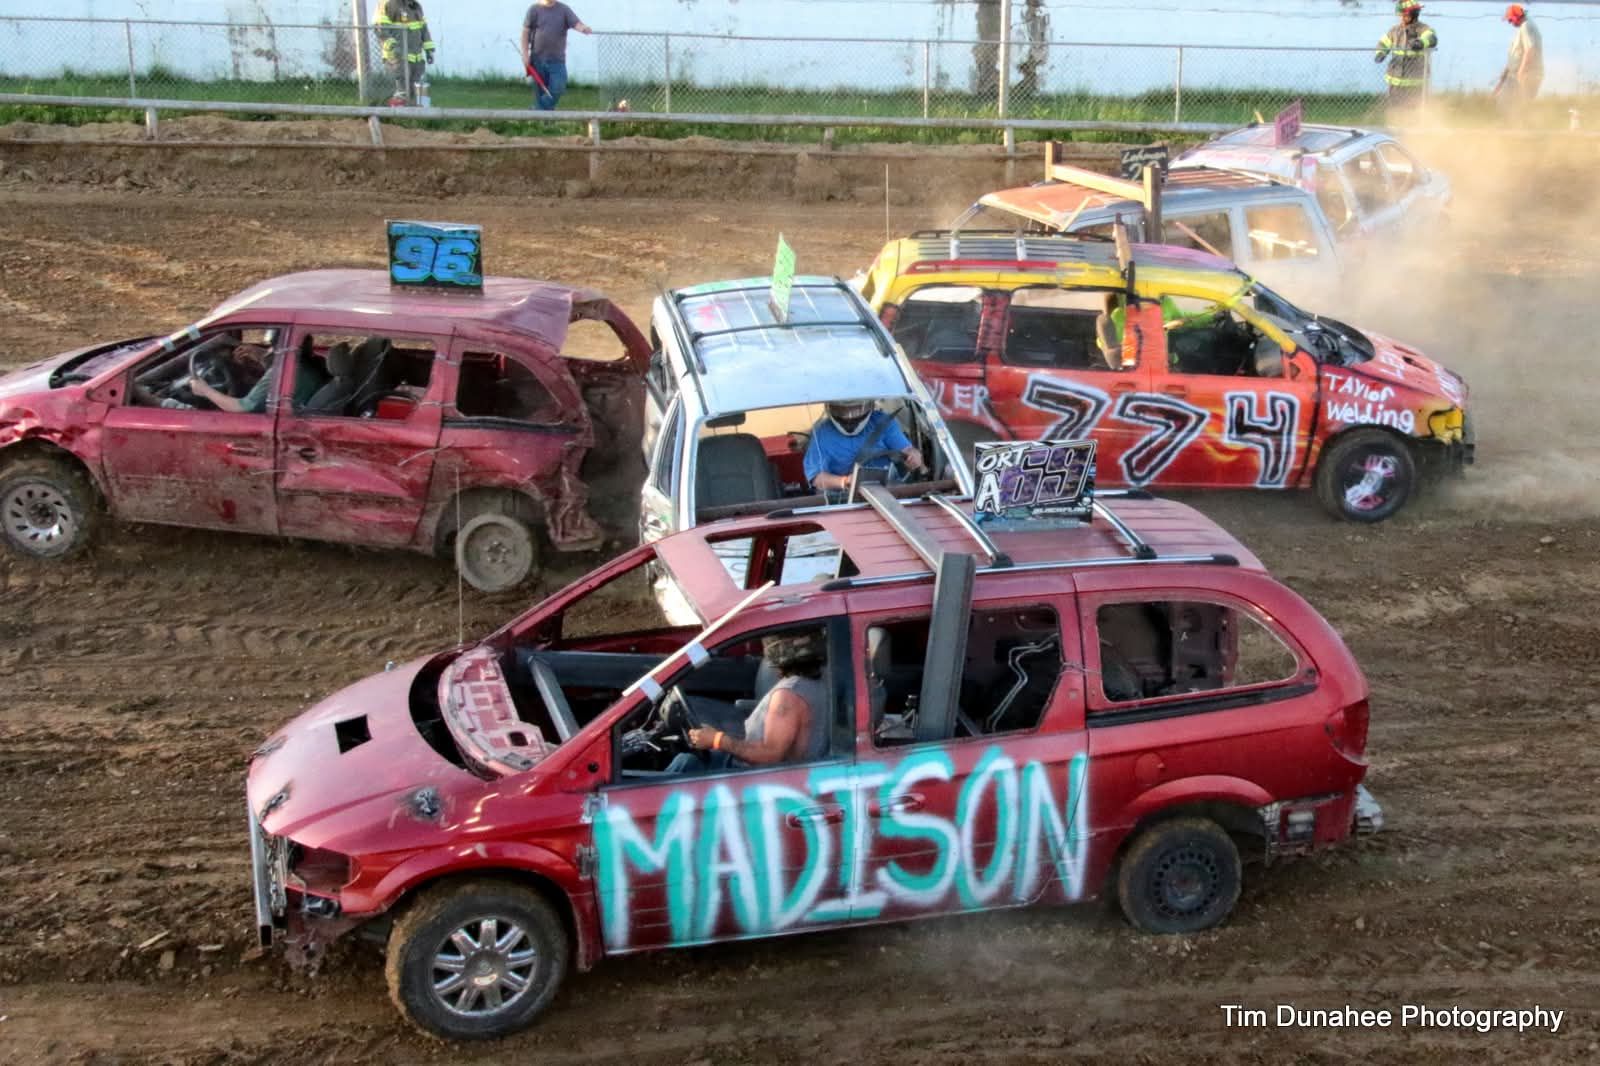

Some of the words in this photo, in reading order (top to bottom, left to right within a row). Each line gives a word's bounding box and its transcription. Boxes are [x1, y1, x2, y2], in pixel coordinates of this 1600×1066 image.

[391, 235, 478, 282] 96
[1023, 373, 1302, 488] 774
[593, 745, 1090, 953] MADISON
